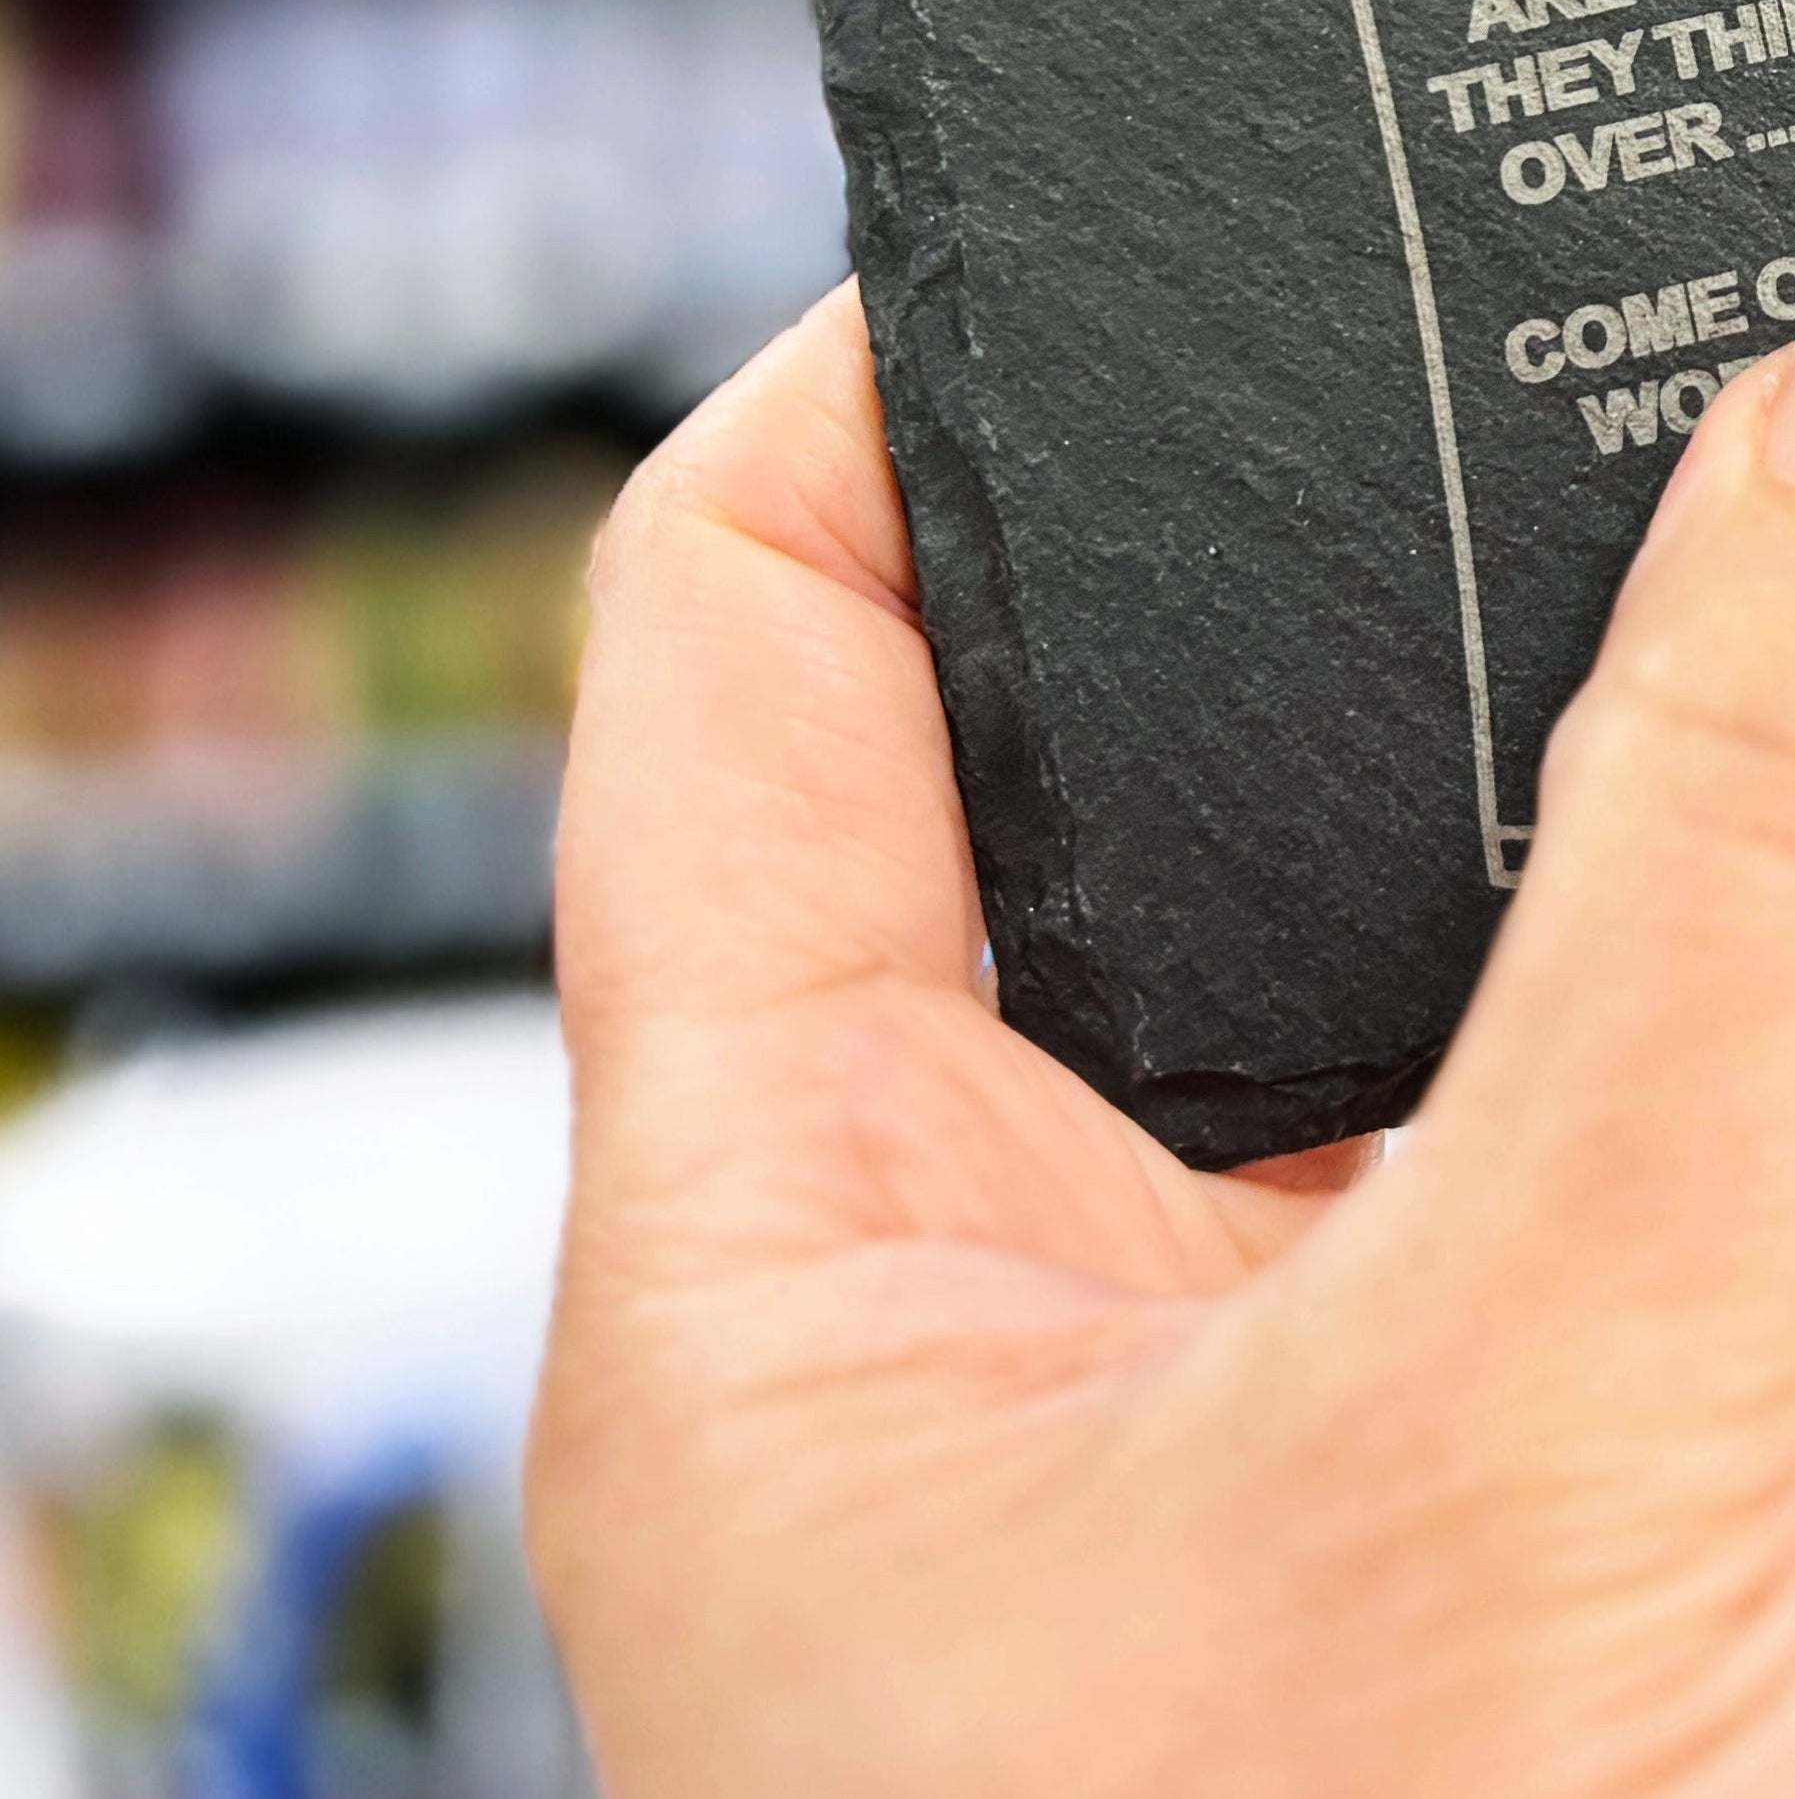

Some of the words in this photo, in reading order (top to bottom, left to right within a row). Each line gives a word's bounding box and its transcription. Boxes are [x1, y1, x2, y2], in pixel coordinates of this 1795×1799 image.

[1428, 30, 1645, 134] THEY
[1500, 103, 1734, 206] OVER
[1504, 270, 1750, 384] COME
